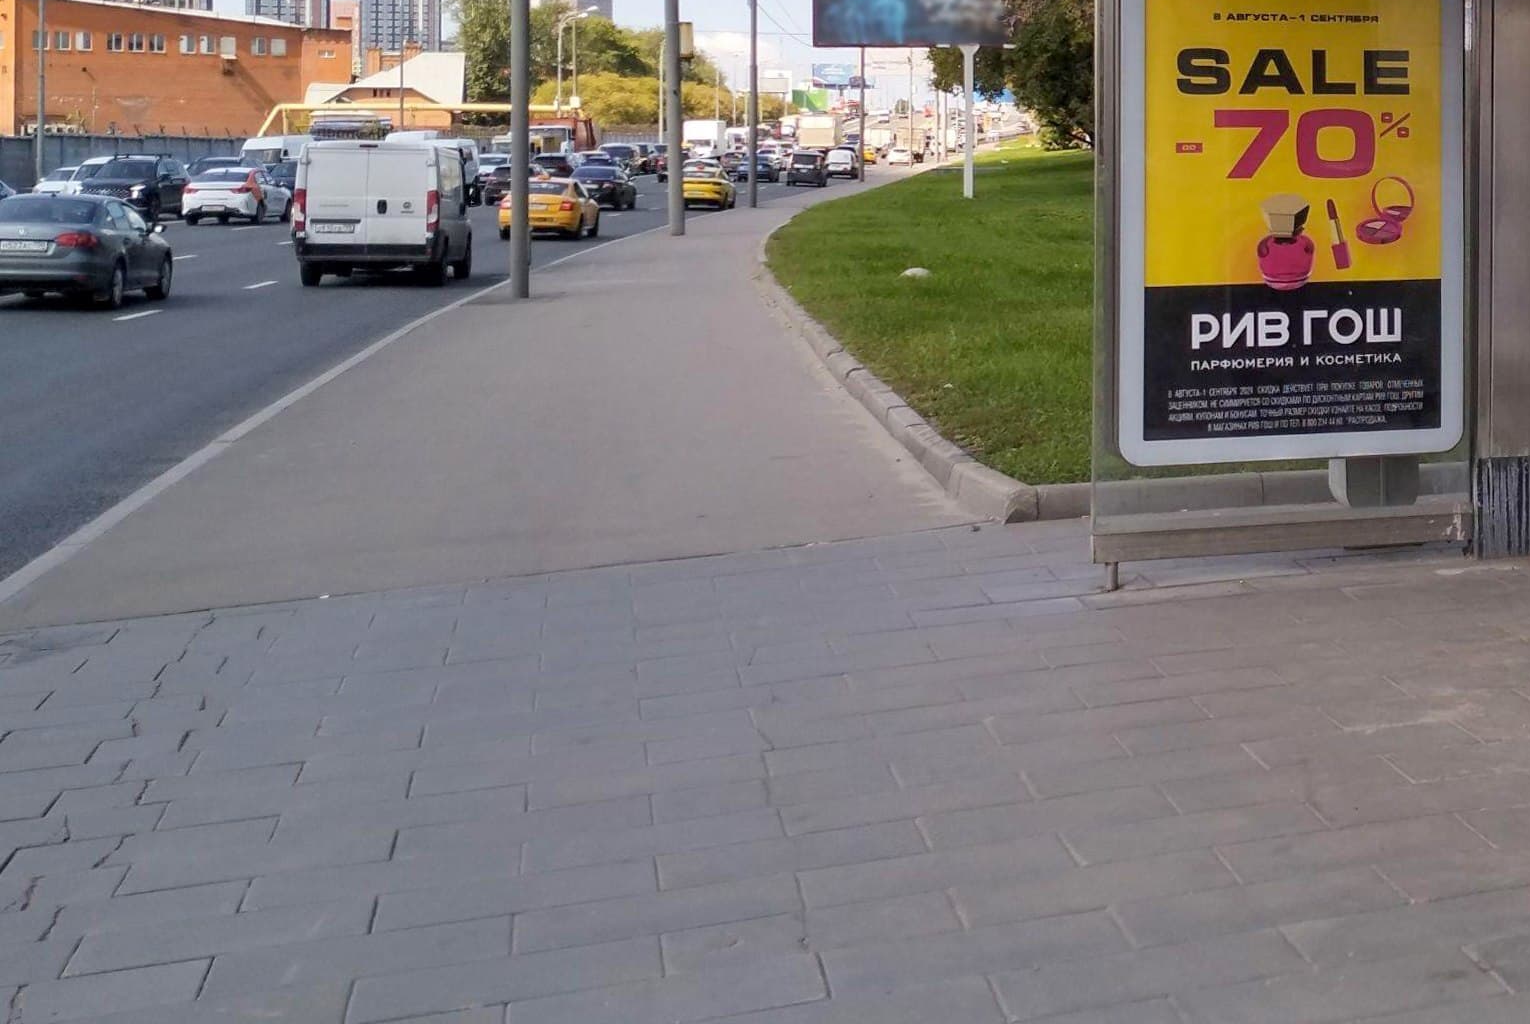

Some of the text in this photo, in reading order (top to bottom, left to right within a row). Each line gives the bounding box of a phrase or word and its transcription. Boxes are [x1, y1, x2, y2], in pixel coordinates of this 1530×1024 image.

[1213, 12, 1221, 21] 8
[1310, 14, 1379, 23] СЕНТЯБРЯ
[1176, 48, 1410, 95] SALE
[1190, 307, 1402, 350] РИВ ГОШ
[1190, 353, 1402, 371] ПАРФЮМЕРИЯ И КОСМЕТИКА
